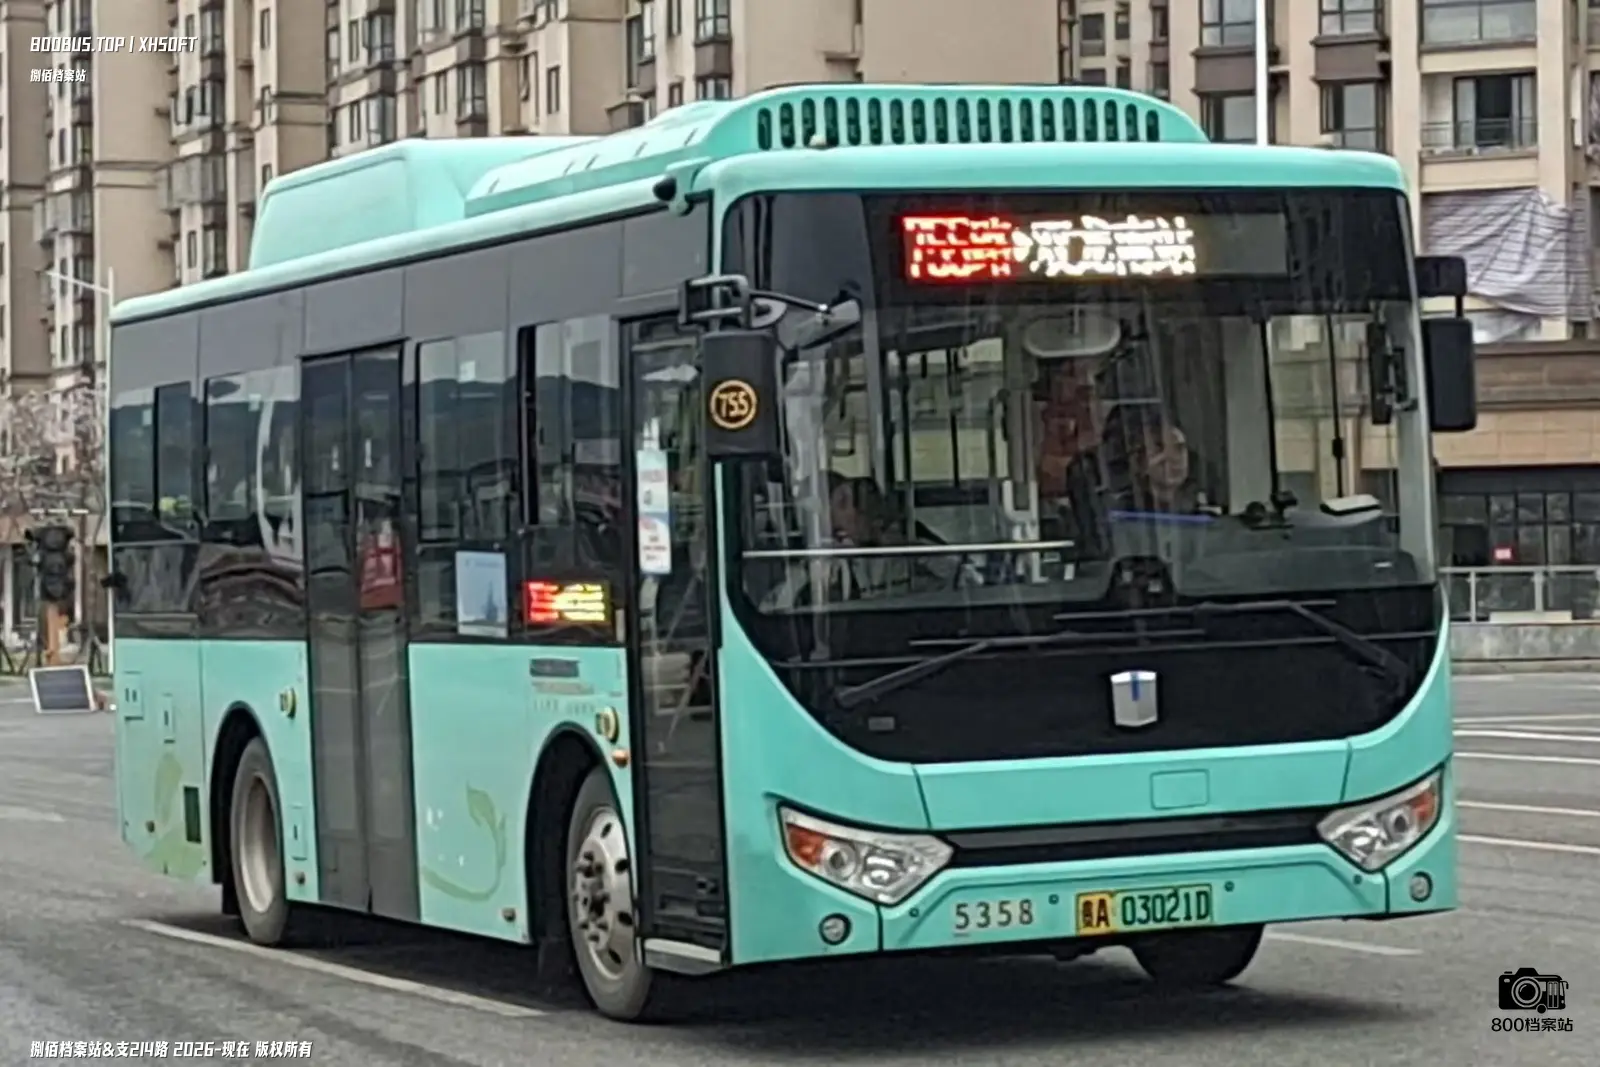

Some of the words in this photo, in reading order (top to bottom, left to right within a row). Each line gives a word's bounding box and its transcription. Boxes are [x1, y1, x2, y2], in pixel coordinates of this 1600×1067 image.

[717, 390, 749, 417] 755
[955, 899, 1034, 930] 5358
[1122, 889, 1210, 926] 03021D
